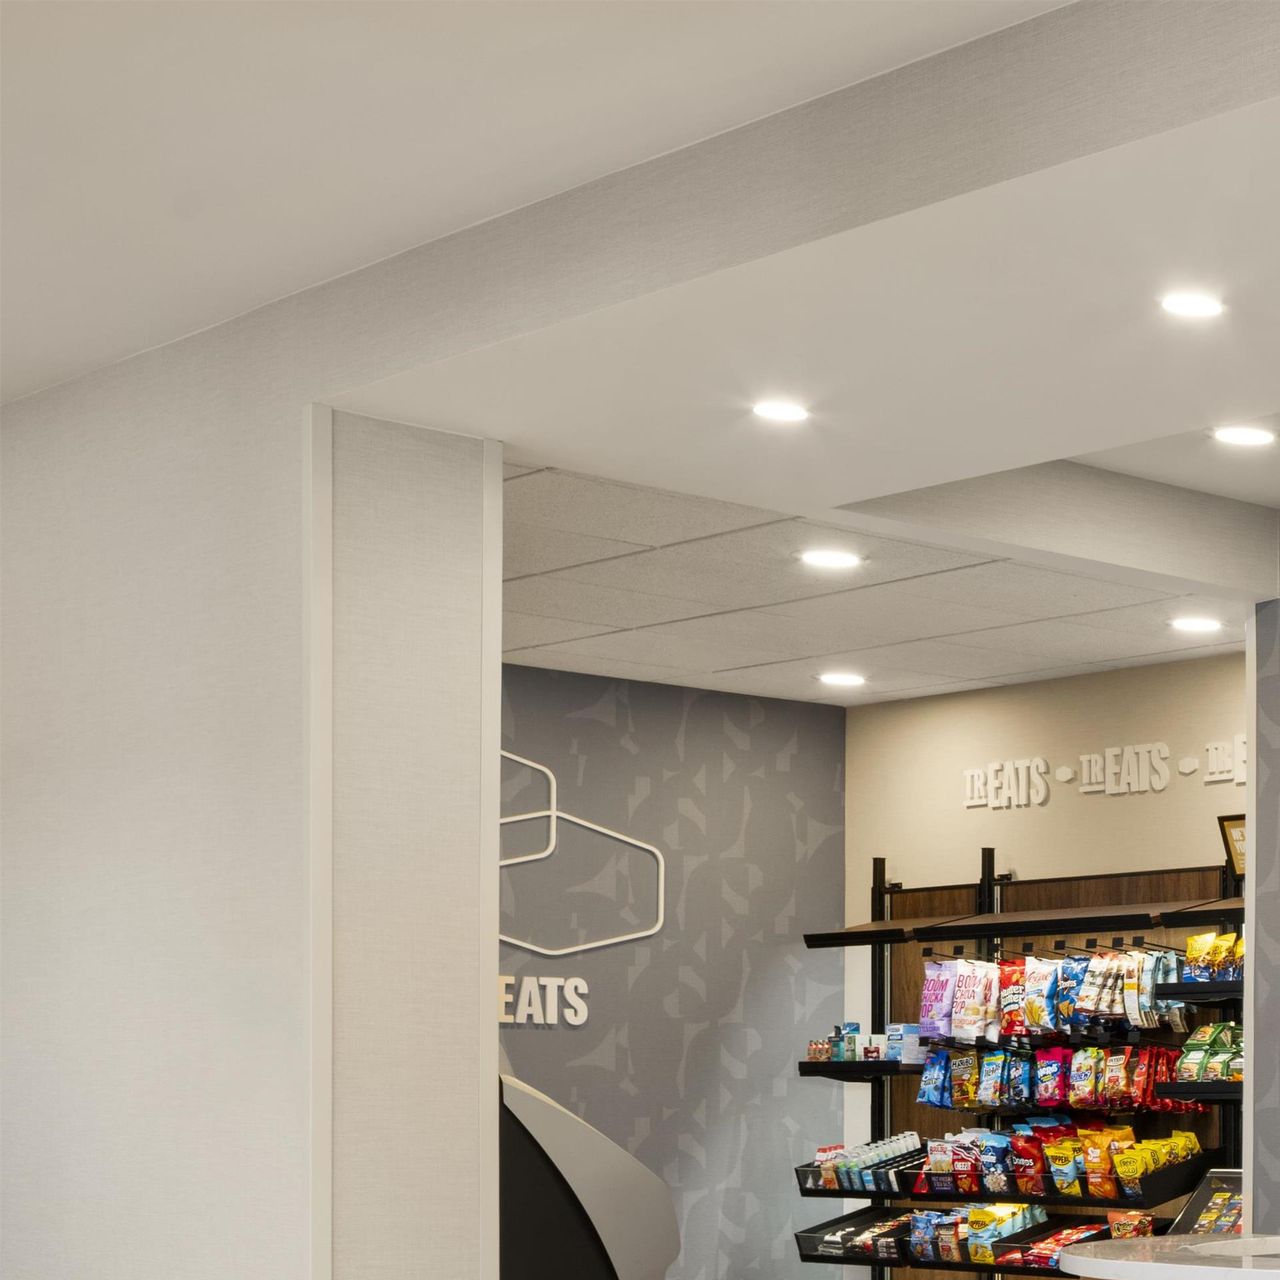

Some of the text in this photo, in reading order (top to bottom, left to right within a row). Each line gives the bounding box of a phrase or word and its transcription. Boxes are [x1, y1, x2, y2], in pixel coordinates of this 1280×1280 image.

[963, 756, 1049, 809] TREATS
[1079, 741, 1170, 795] TREATS
[1013, 1156, 1035, 1166] Doritos
